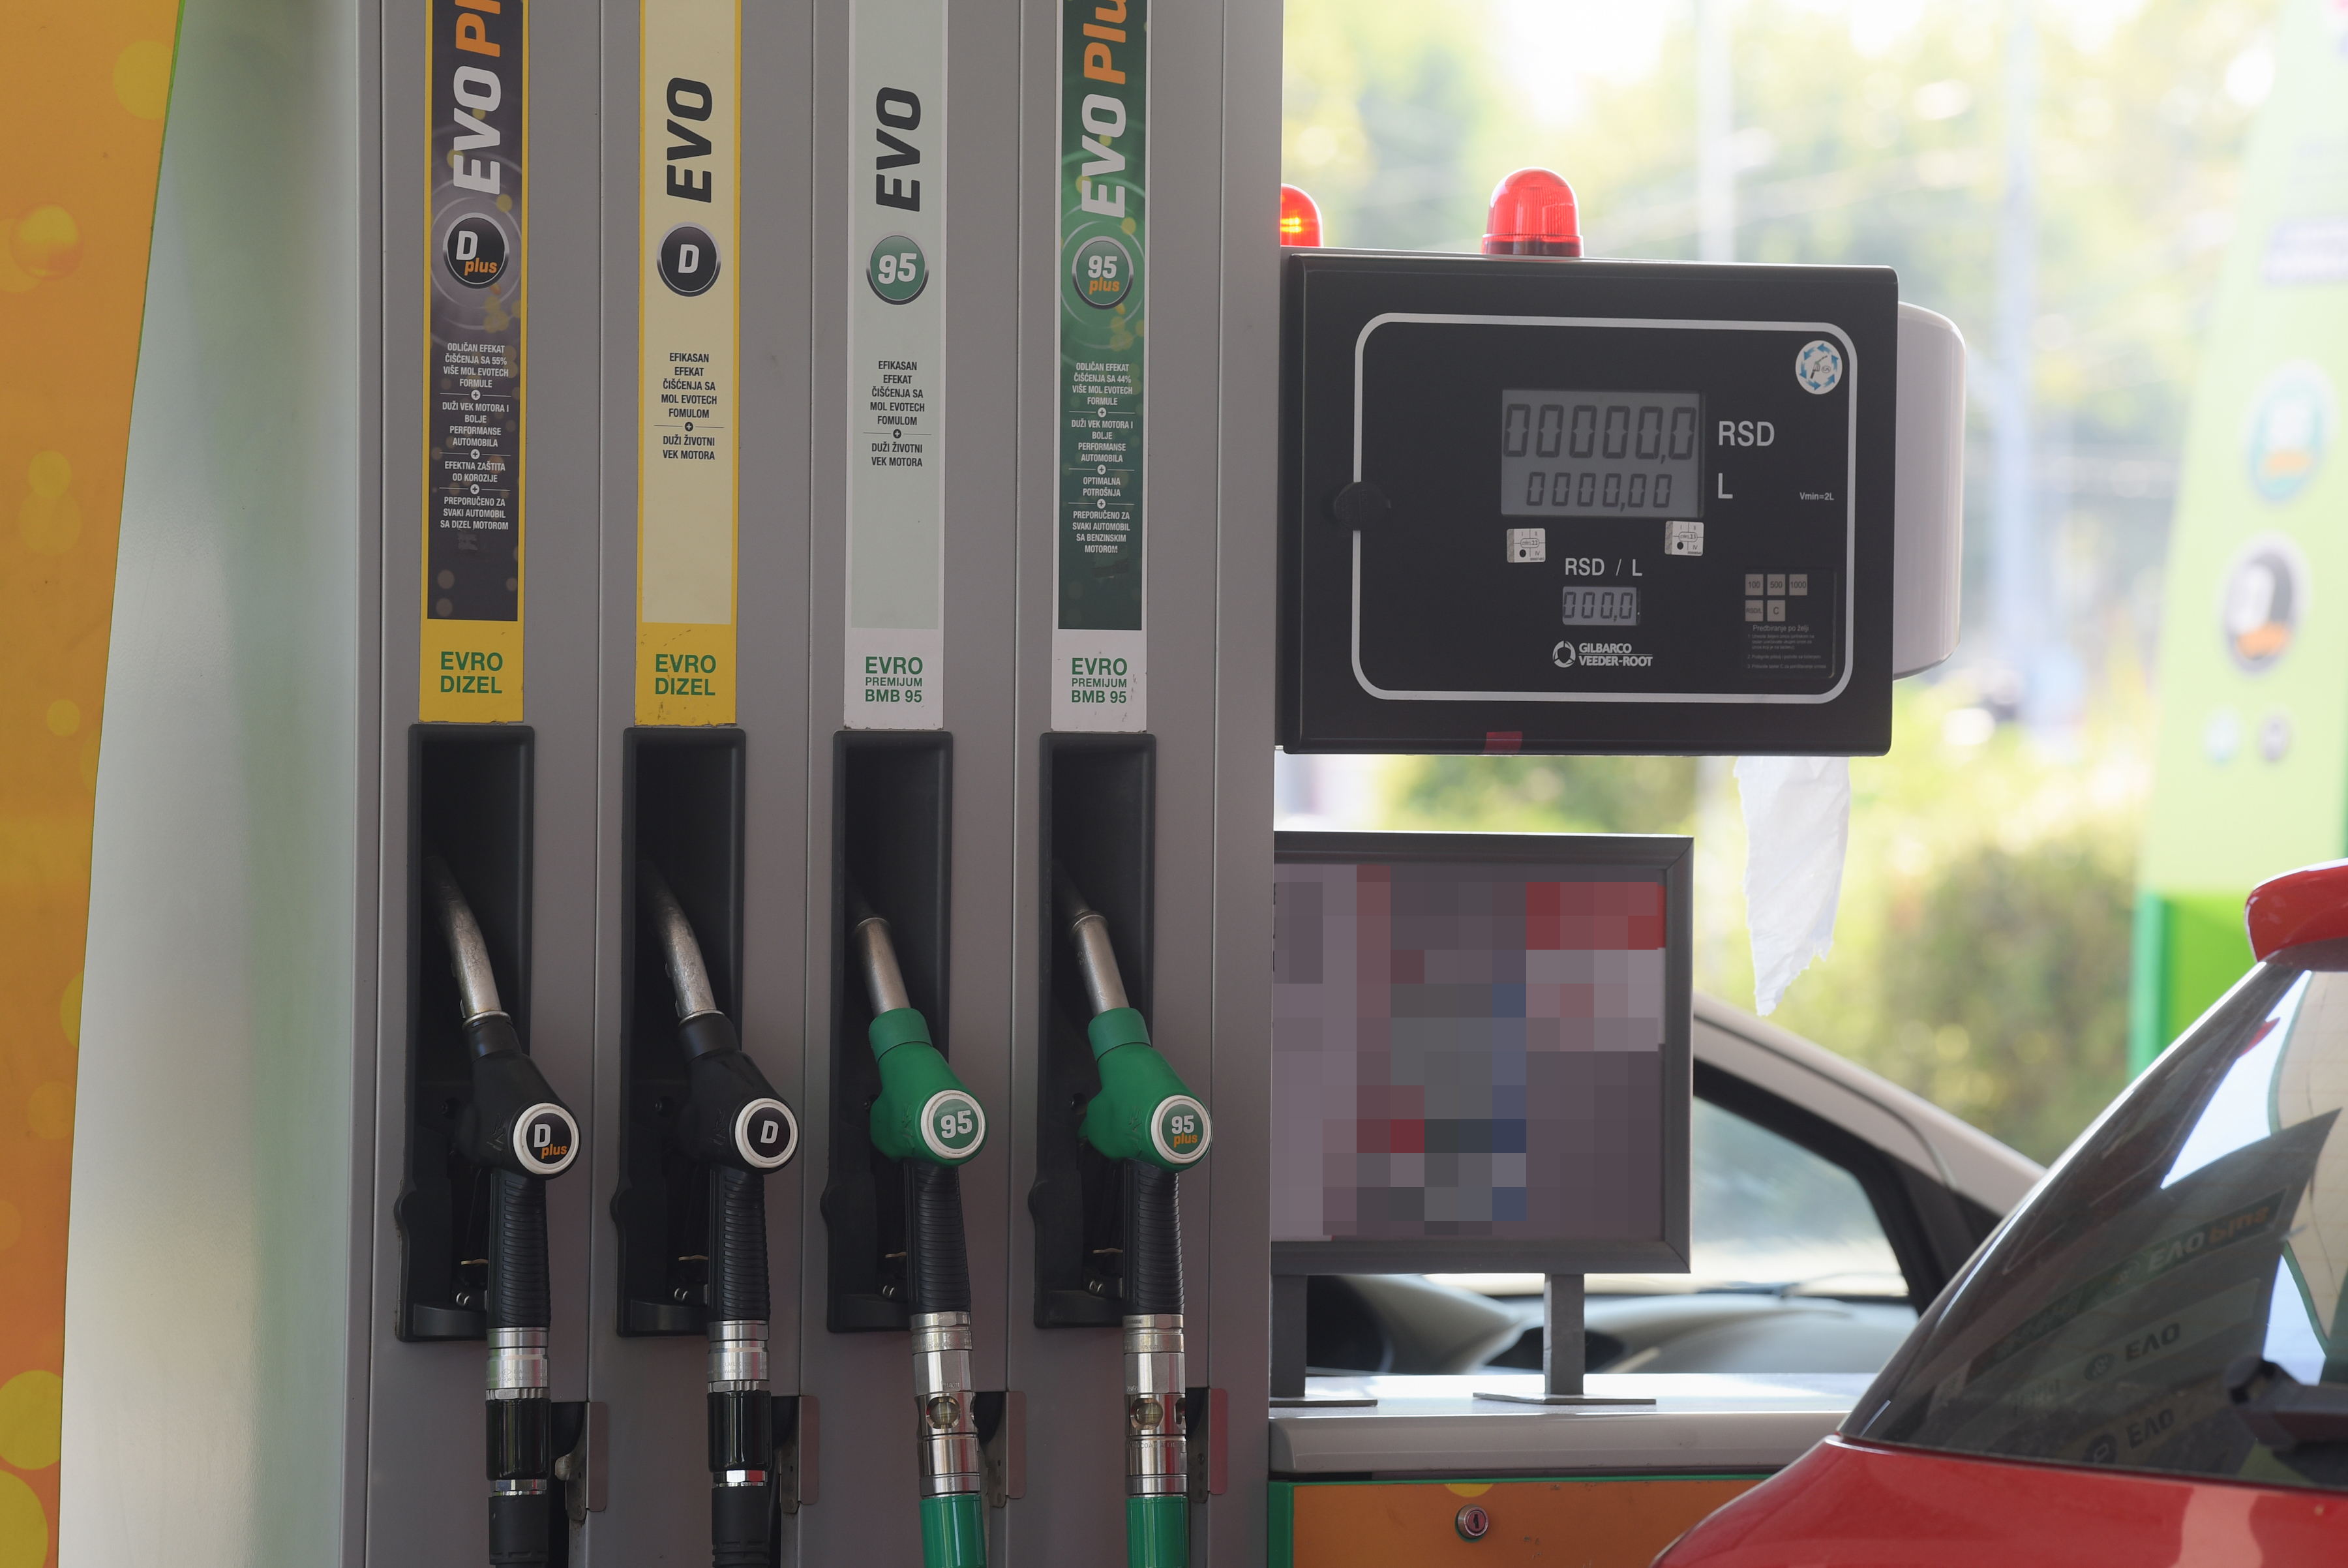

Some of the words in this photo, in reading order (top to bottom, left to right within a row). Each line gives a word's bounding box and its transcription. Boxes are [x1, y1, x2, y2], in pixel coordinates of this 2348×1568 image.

[455, 0, 501, 57] Pl
[1083, 0, 1127, 85] Plu
[453, 65, 502, 195] EVO
[666, 77, 712, 204] EVO
[875, 87, 921, 212] EVO
[1081, 93, 1127, 219] EVO
[456, 230, 477, 261] D
[678, 244, 699, 274] D
[464, 258, 497, 276] plus
[877, 253, 918, 284] 95
[1087, 255, 1117, 279] 95
[1089, 277, 1120, 295] plus
[447, 342, 477, 352] ODLIČAN
[479, 344, 505, 353] EFEKAT
[445, 353, 479, 364] ČIŠĆENJA
[492, 357, 507, 365] 55%
[670, 353, 709, 363] EFIKASAN
[444, 365, 459, 375] VIŠE
[460, 367, 476, 376] MOL
[477, 368, 508, 377] EVOTECH
[674, 367, 704, 376] EFEKAT
[879, 361, 917, 370] EFIKASAN
[1076, 361, 1104, 371] ODLIČAN
[1106, 363, 1129, 372] EFEKAT
[460, 378, 492, 387] FORMULE
[663, 378, 702, 390] ČIŠĆENJA
[704, 382, 715, 391] SA
[883, 374, 912, 384] EFEKAT
[1074, 373, 1105, 382] ČIŠĆENJA
[1117, 375, 1131, 384] 44%
[872, 386, 911, 398] ČIŠĆENJA
[912, 389, 924, 398] SA
[1072, 384, 1087, 393] VIŠE
[1088, 385, 1102, 394] MOL
[1104, 386, 1132, 395] EVOTECH
[661, 394, 679, 404] MOL
[682, 395, 717, 404] EVOTECH
[1087, 397, 1118, 406] FORMULE
[442, 400, 458, 410] DUŽI
[460, 402, 474, 411] VEK
[475, 403, 505, 412] MOTORA
[870, 402, 888, 411] MOL
[890, 402, 925, 412] EVOTECH
[669, 408, 710, 418] FOMULOM
[877, 415, 917, 425] FOMULOM
[1072, 419, 1086, 428] DUŽI
[1102, 420, 1130, 429] MOTORA
[449, 426, 501, 436] PERFORMANSE
[1718, 421, 1775, 446] RSD
[453, 437, 498, 447] AUTOMOBILA
[663, 434, 681, 445] DUŽI
[684, 434, 715, 446] ŽIVOTNI
[872, 442, 890, 452] DUŽI
[892, 442, 922, 453] ŽIVOTNI
[1078, 442, 1126, 451] PERFORMANSE
[663, 450, 678, 459] VEK
[681, 450, 715, 460] MOTORA
[1081, 454, 1123, 462] AUTOMOBILA
[445, 461, 475, 470] EFEKTNA
[477, 460, 505, 471] ZAŠTITA
[871, 457, 887, 466] VEK
[889, 457, 923, 466] MOTORA
[464, 474, 498, 483] KOROZIJE
[1083, 477, 1121, 485] OPTIMALNA
[1083, 487, 1121, 497] POTROŠNJA
[1717, 473, 1733, 499] L
[444, 497, 494, 506] PREPORUČENO
[496, 498, 505, 507] ZA
[1799, 492, 1834, 501] Vmin=2L
[444, 508, 464, 517] SVAKI
[465, 509, 505, 519] AUTOMOBIL
[1073, 510, 1120, 519] PREPORUČENO
[1121, 511, 1130, 520] ZA
[440, 520, 450, 528] SA
[452, 520, 471, 529] DIZEL
[473, 521, 508, 530] MOTOROM
[1087, 534, 1126, 542] BENZINSKIM
[1565, 558, 1604, 575] RSD
[1616, 559, 1622, 576] /
[1632, 560, 1642, 576] L
[1579, 642, 1632, 654] GILBARCO
[440, 652, 504, 671] EVRO
[655, 654, 716, 673] EVRO
[865, 656, 923, 674] EVRO
[1072, 657, 1128, 676] EVRO
[1578, 656, 1653, 667] VEEDER-ROOT
[440, 676, 502, 694] DIZEL
[655, 678, 715, 696] DIZEL
[865, 677, 923, 687] PREMIJUM
[1072, 678, 1127, 688] PREMIJUM
[865, 689, 900, 702] BMB
[905, 690, 922, 703] 95
[1072, 690, 1106, 703] BMB
[1110, 691, 1127, 704] 95
[941, 1110, 972, 1138] 95
[1171, 1115, 1194, 1134] 95
[534, 1124, 550, 1148] D
[760, 1120, 779, 1144] D
[1173, 1132, 1197, 1147] plus
[541, 1142, 567, 1159] plus
